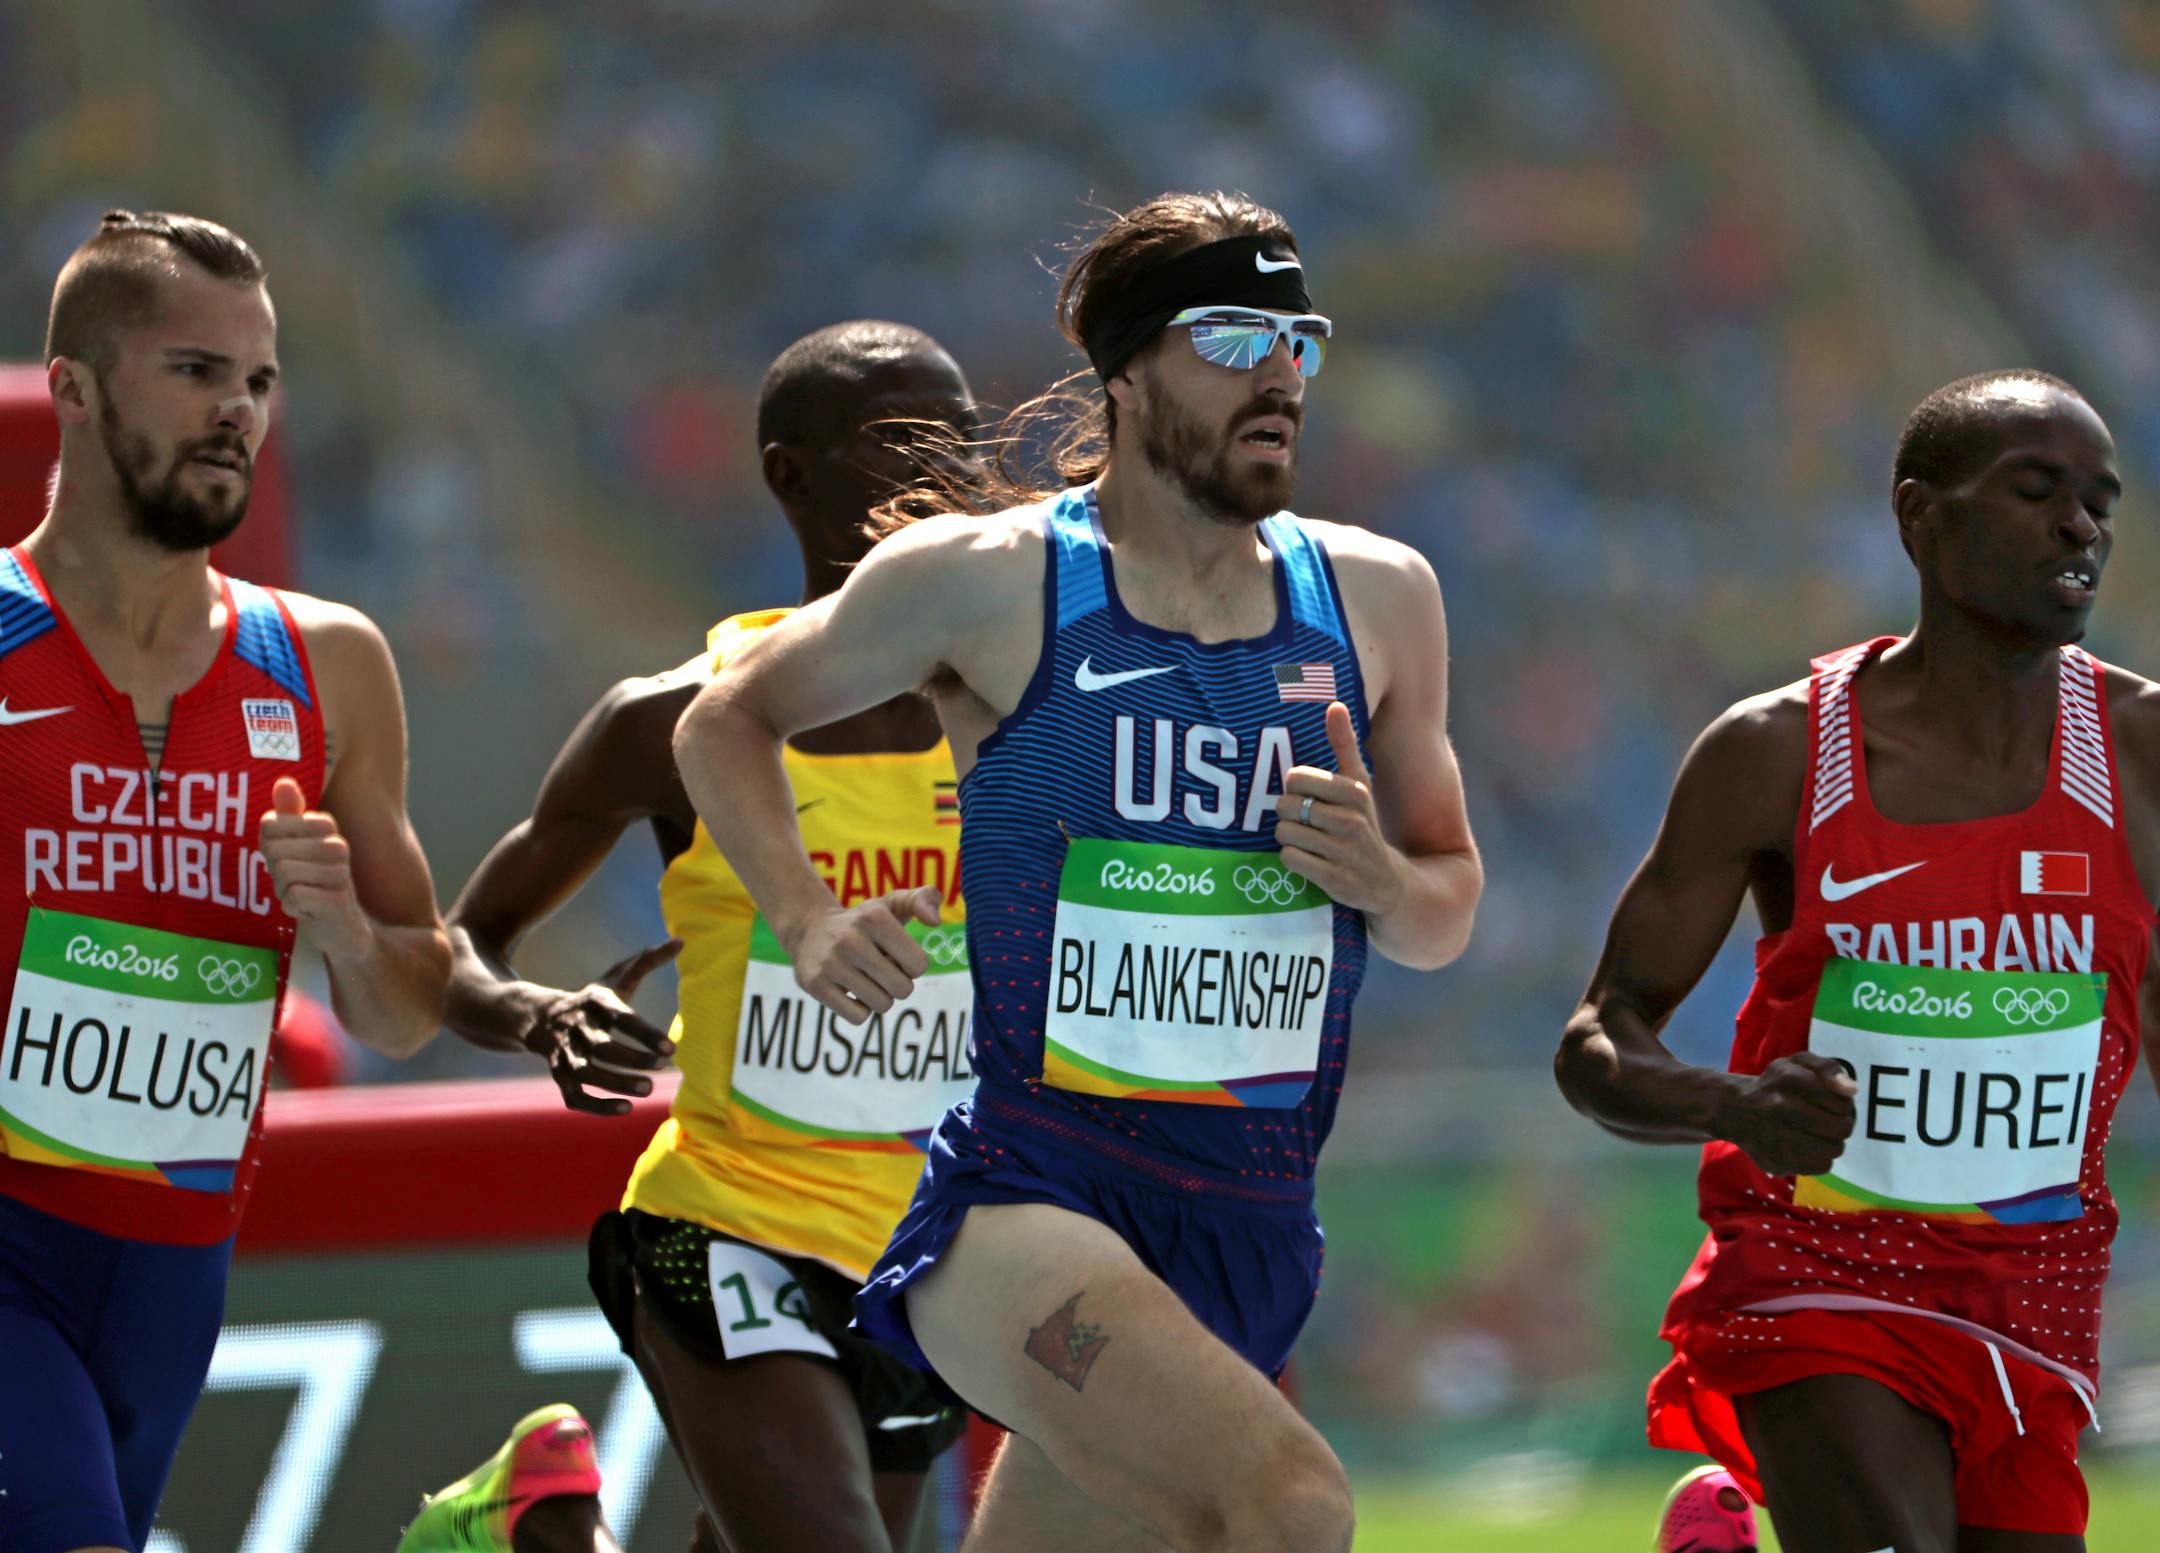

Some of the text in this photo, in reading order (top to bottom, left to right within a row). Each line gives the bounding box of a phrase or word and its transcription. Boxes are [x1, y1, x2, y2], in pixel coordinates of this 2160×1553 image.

[70, 762, 249, 837] CZECH
[1113, 714, 1294, 833] USA
[25, 828, 271, 916] REPUBLIC
[809, 848, 962, 908] GAND
[1056, 937, 1326, 1030] BLANKENSHIP
[1825, 913, 2095, 975] BAHRAIN
[9, 1006, 256, 1120] HOLUSA
[743, 995, 976, 1081] MUSAGAL
